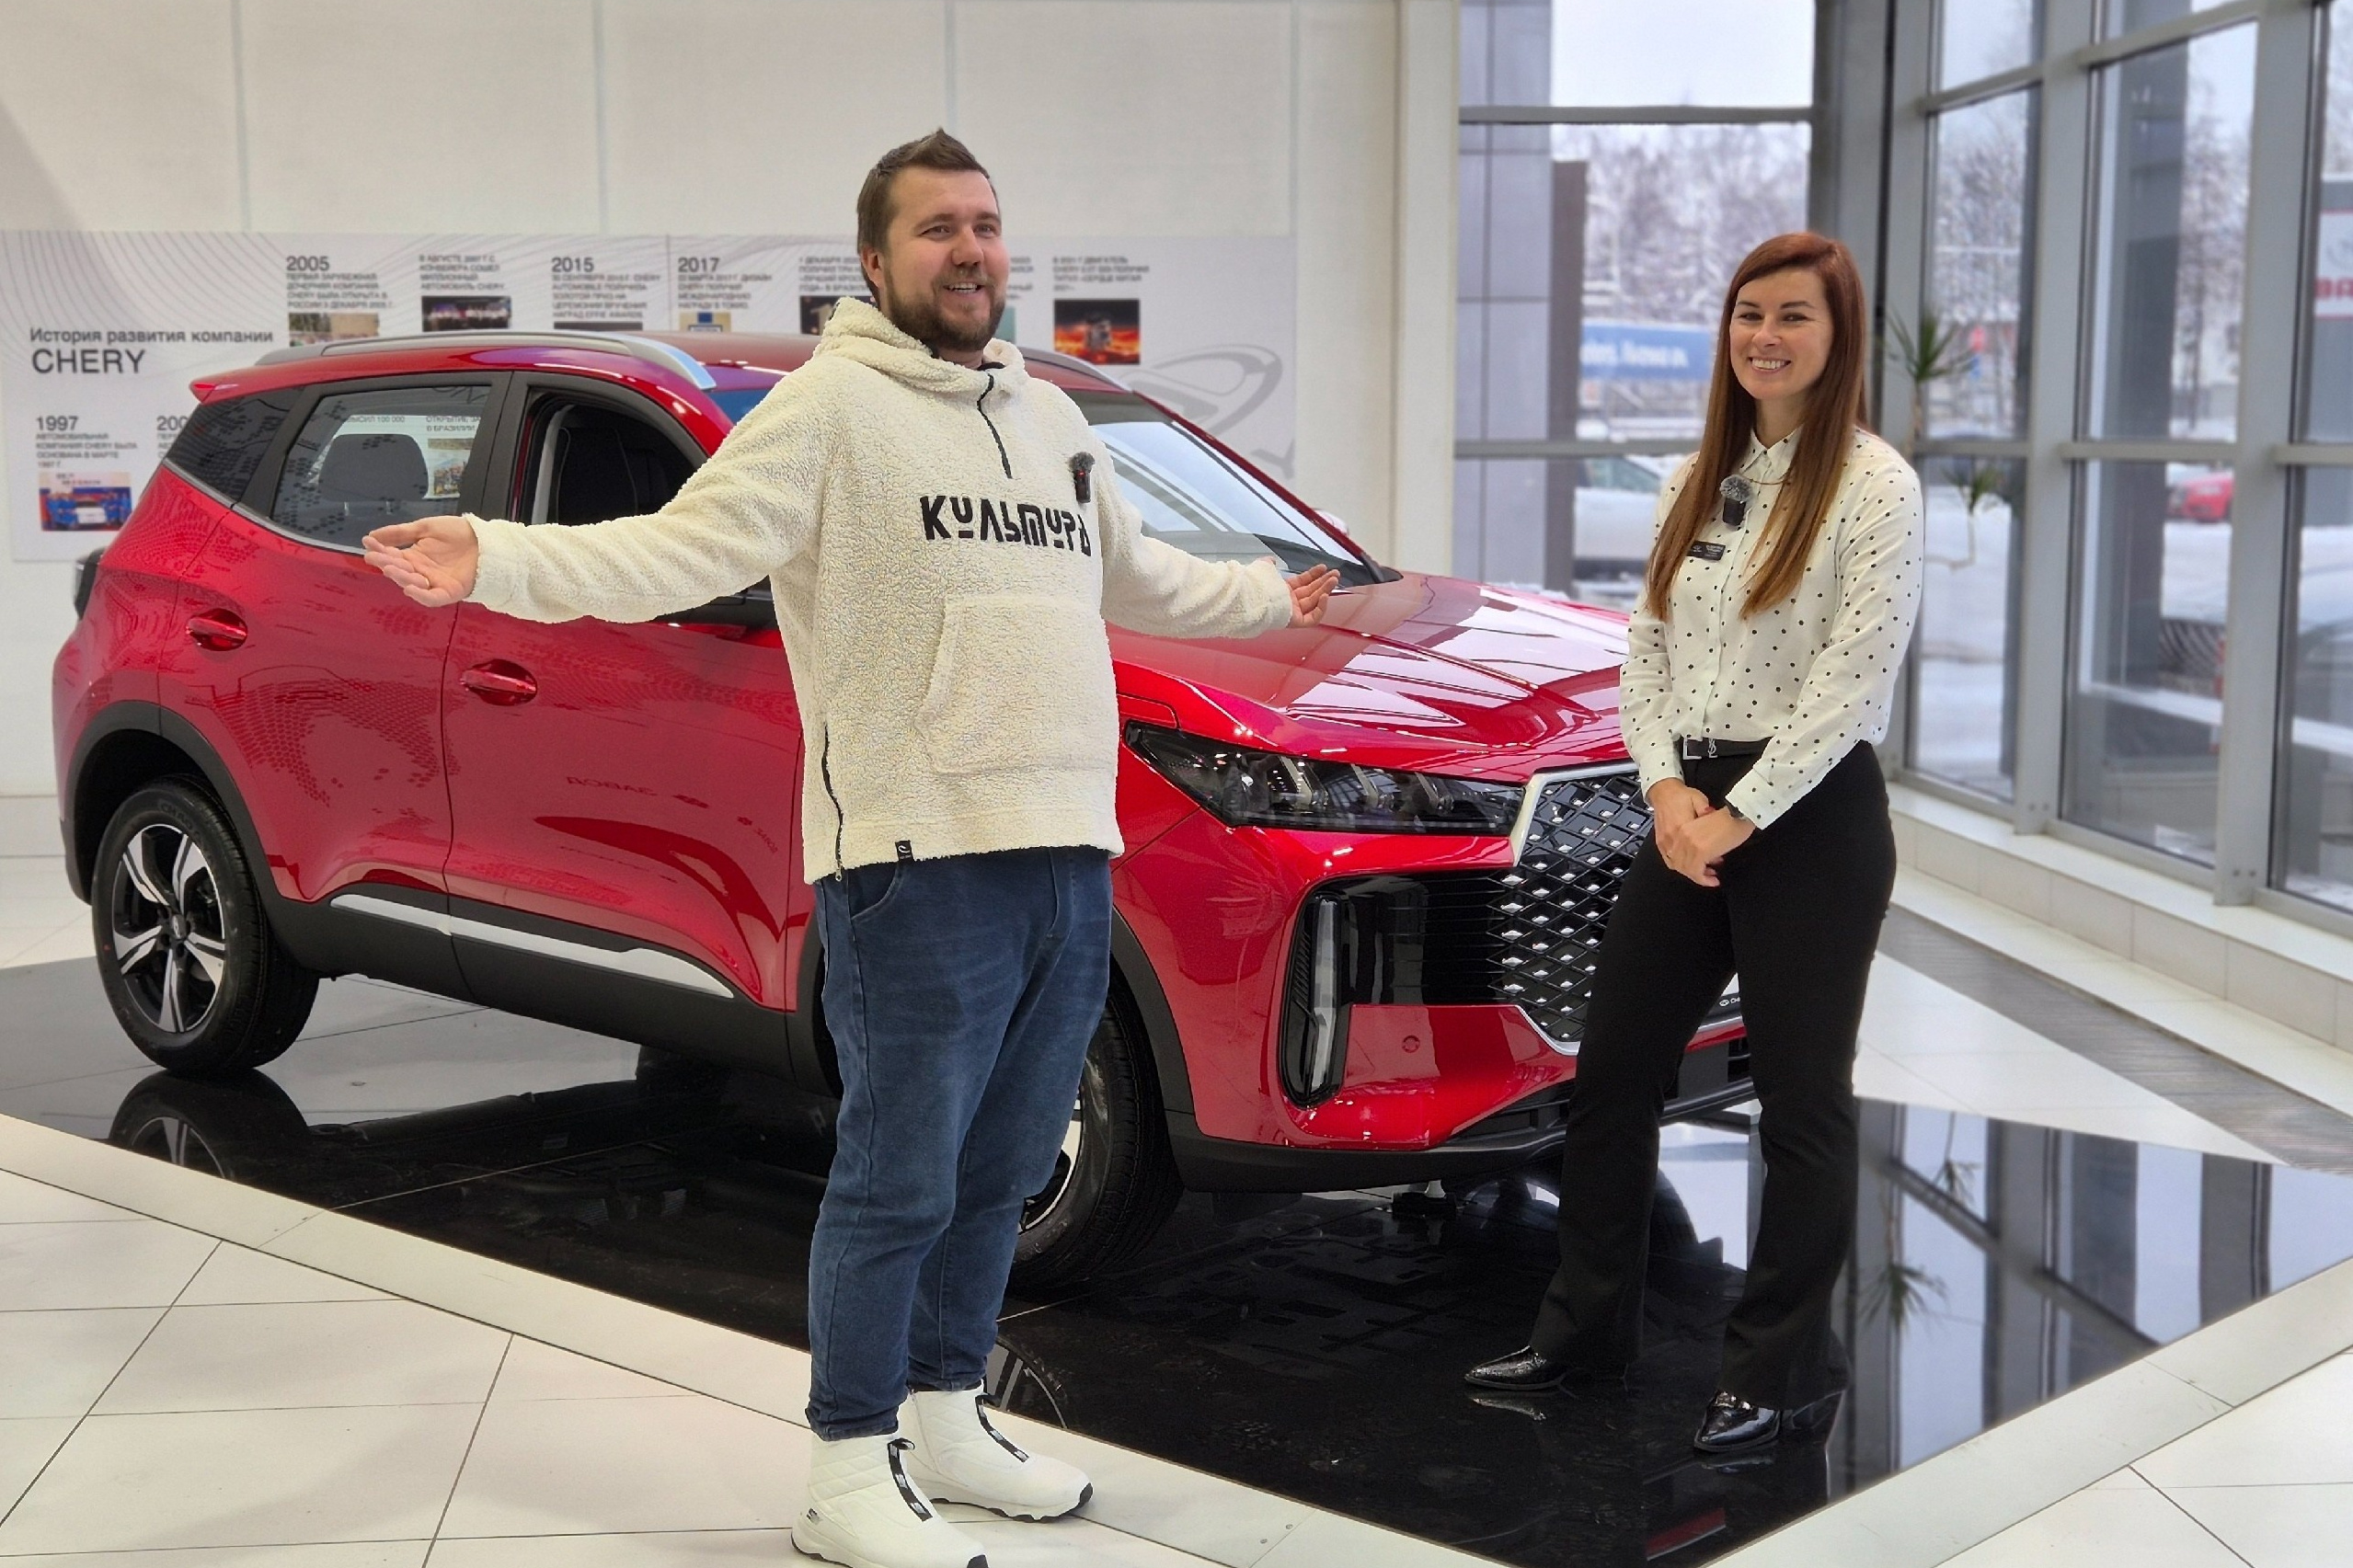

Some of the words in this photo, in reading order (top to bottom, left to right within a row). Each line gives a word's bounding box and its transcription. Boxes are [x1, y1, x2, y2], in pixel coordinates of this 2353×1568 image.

[286, 256, 329, 271] 2005
[552, 257, 594, 273] 2015
[678, 257, 719, 272] 2017
[30, 327, 102, 345] История
[108, 330, 185, 345] развития
[191, 329, 274, 343] компании
[31, 349, 145, 373] CHERY
[36, 416, 78, 431] 1997
